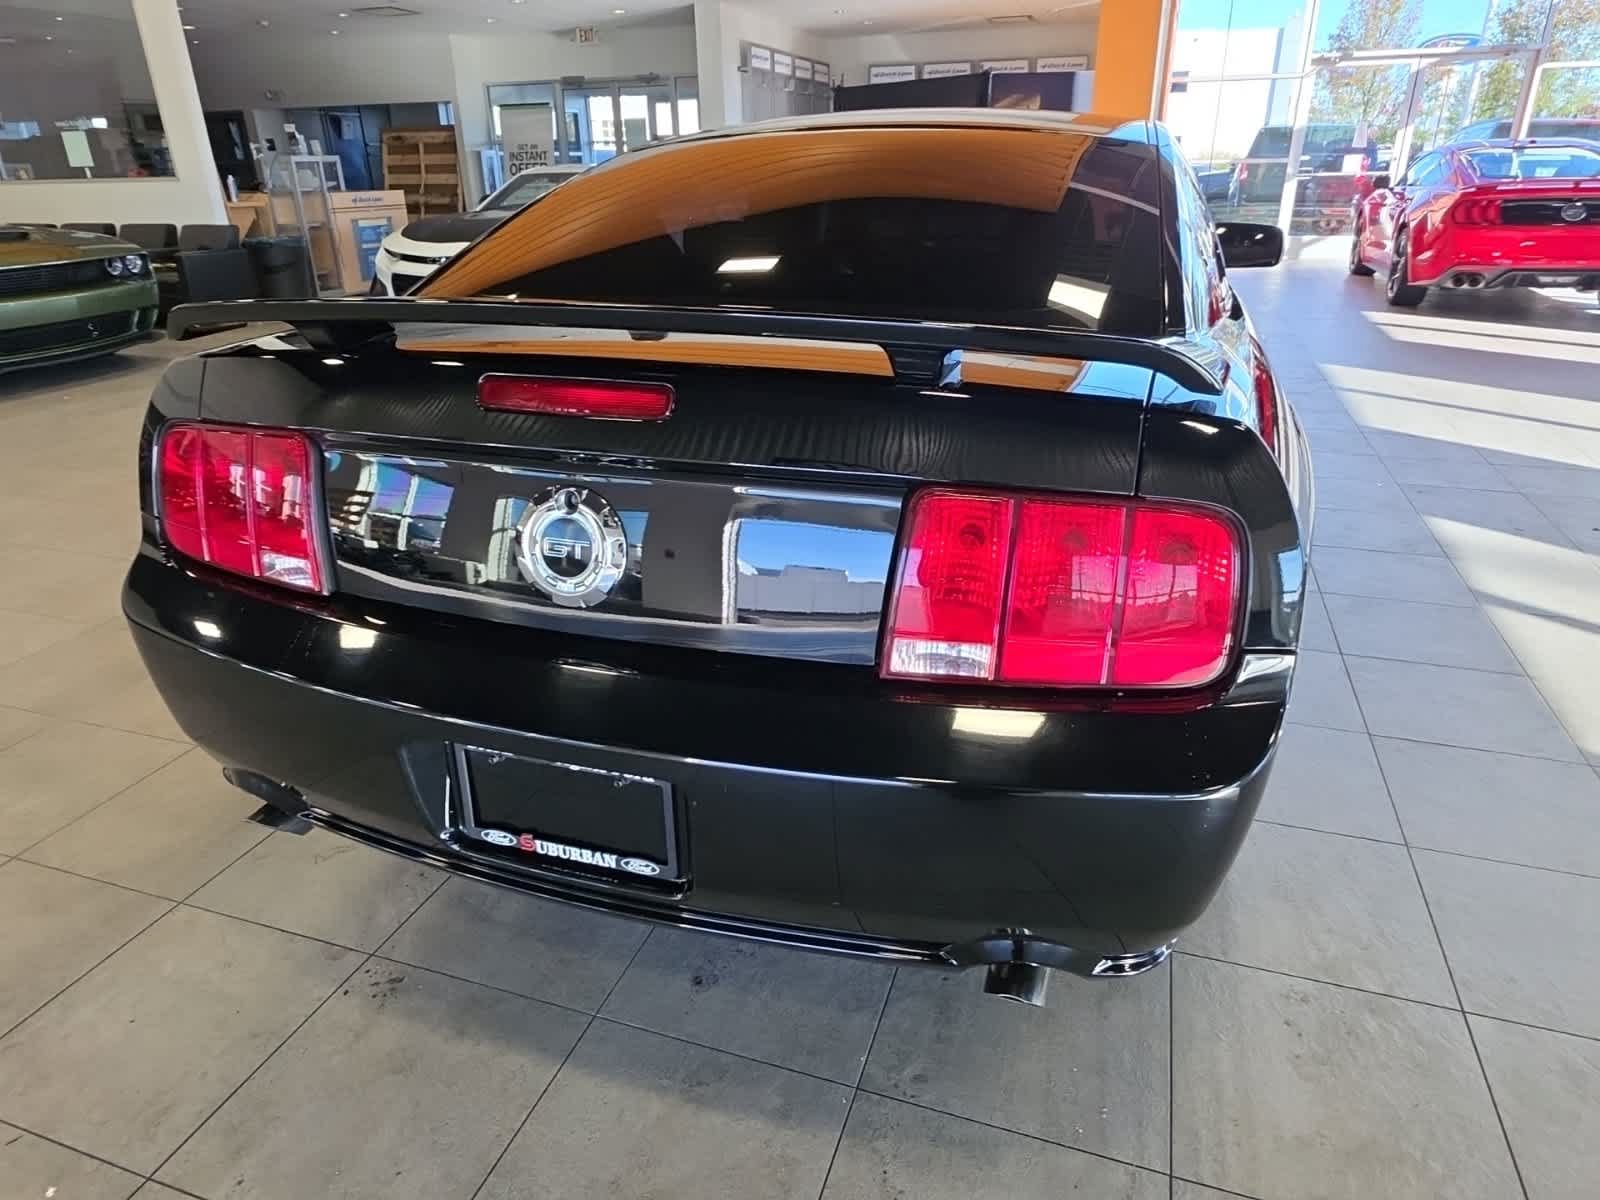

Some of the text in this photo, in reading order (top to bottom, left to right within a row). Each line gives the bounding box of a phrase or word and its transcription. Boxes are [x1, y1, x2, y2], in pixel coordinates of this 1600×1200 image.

[579, 29, 593, 43] EXIT
[509, 151, 547, 161] INSTANT
[508, 162, 548, 176] OFF
[543, 537, 591, 560] GT
[519, 833, 618, 868] SUBURBAN
